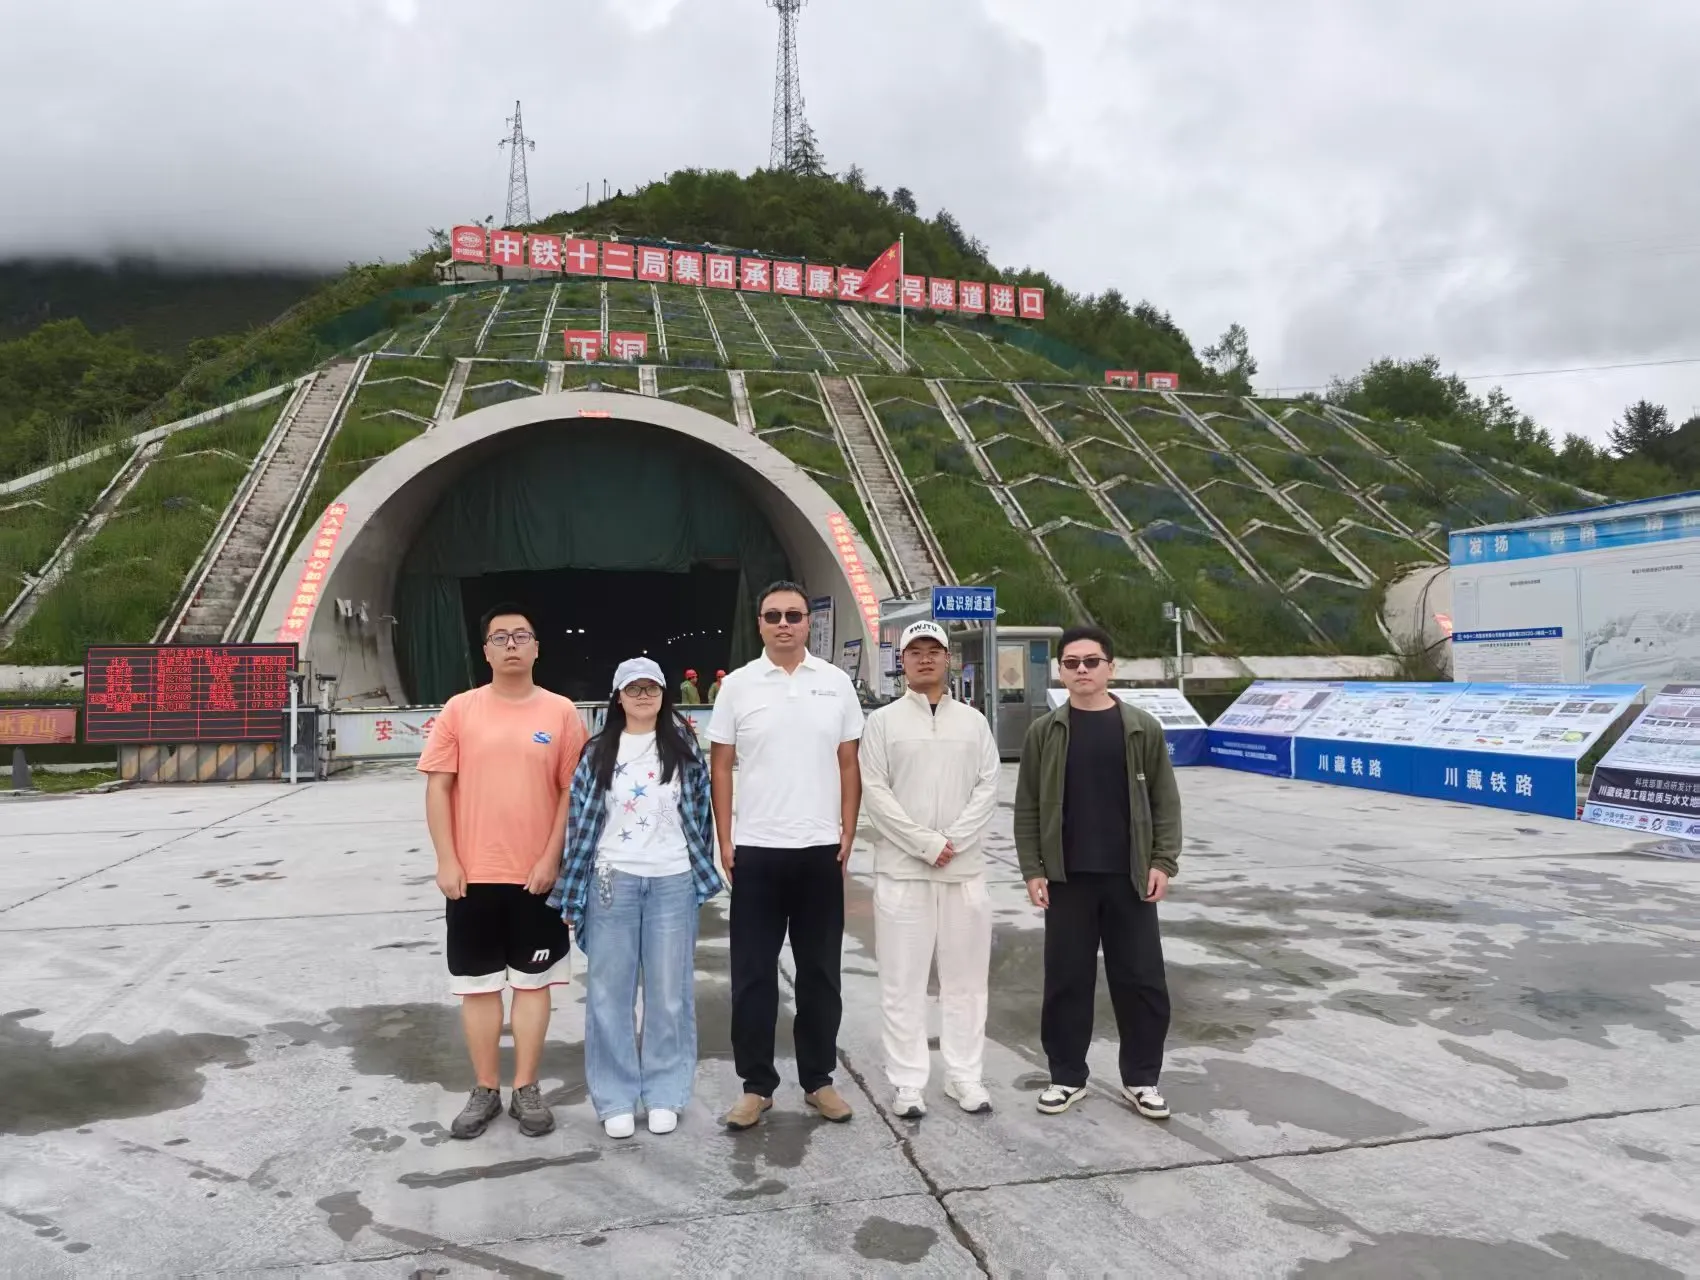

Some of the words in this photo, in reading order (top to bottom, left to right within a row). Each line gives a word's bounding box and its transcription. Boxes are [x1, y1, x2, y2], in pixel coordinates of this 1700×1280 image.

[936, 594, 993, 612] 人脸识别通道
[1318, 754, 1382, 778] 川藏铁路
[1444, 767, 1533, 797] 川藏铁路
